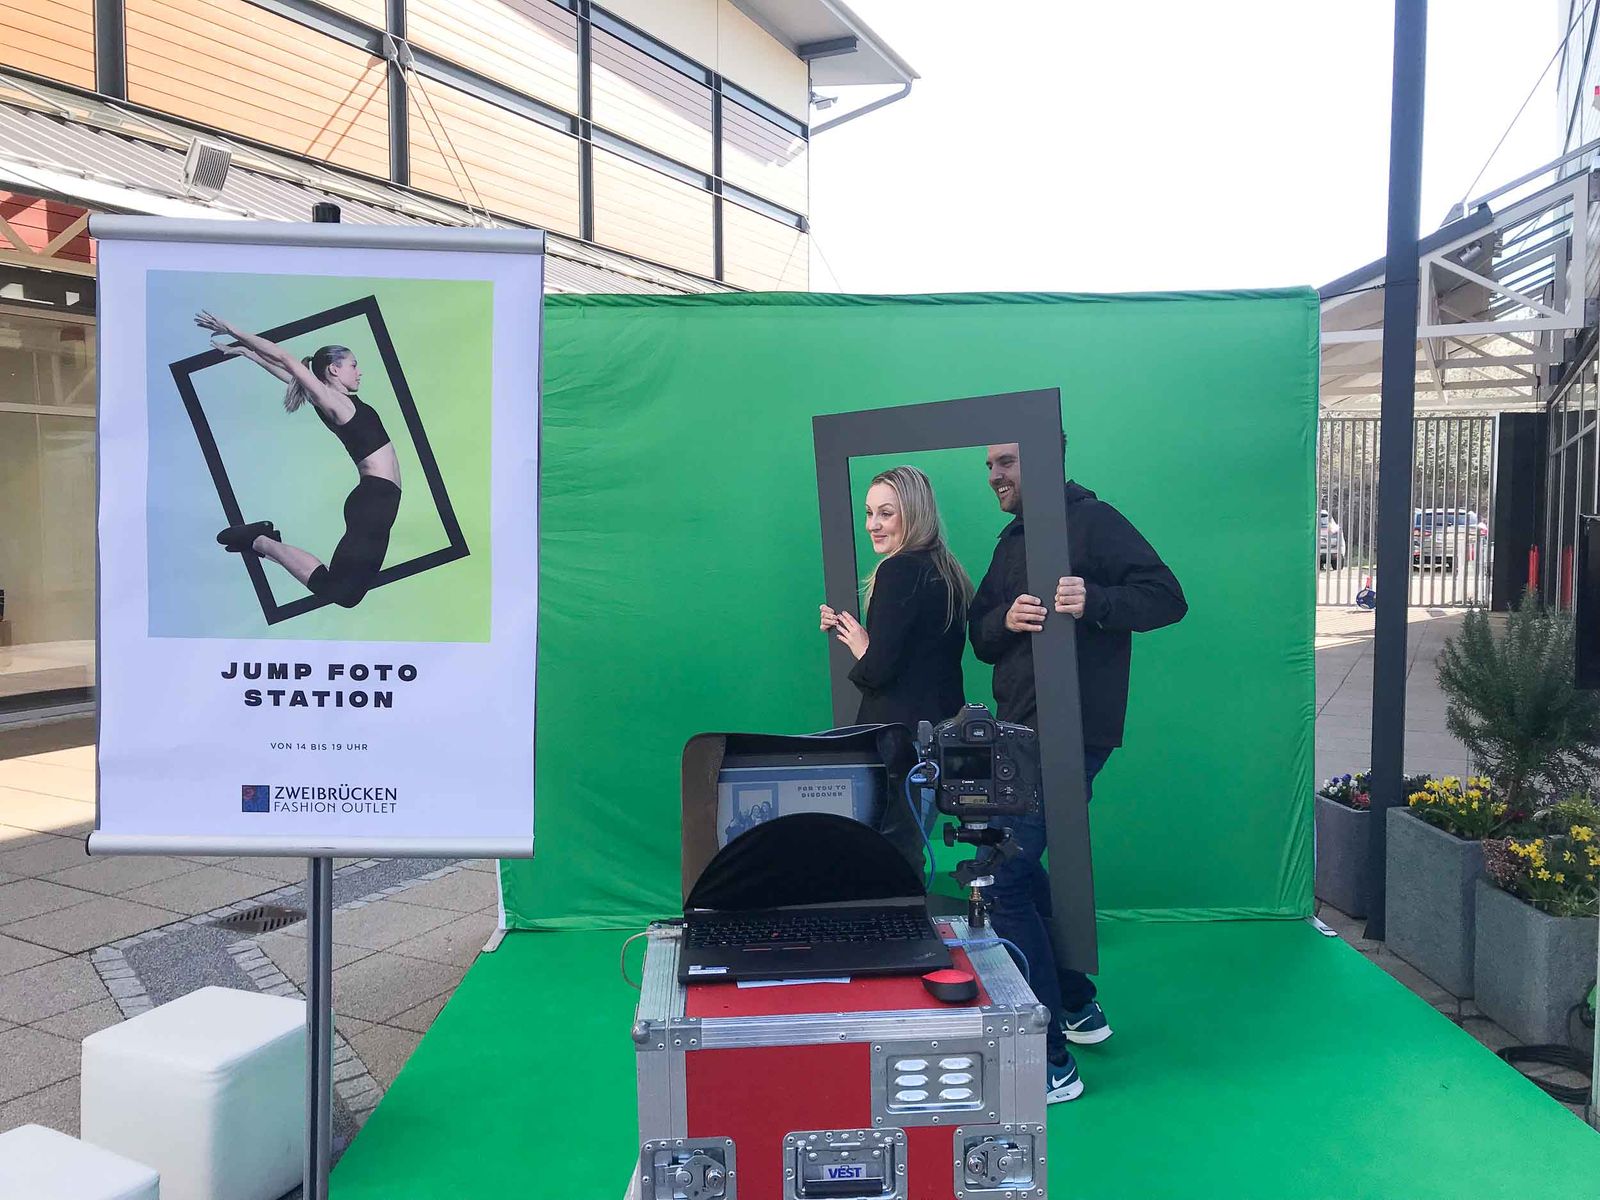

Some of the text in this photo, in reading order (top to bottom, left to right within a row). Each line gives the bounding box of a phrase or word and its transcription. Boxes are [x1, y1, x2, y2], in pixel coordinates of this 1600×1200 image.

[221, 662, 417, 681] JUMP FOTO
[244, 689, 393, 708] STATION
[270, 742, 292, 750] VON
[310, 743, 327, 751] BIS
[331, 743, 342, 751] 19
[346, 743, 368, 751] UHR
[274, 784, 397, 800] ZWEIBRÜCKEN
[274, 801, 397, 813] FASHION OUTLET
[828, 1167, 862, 1178] VEST
